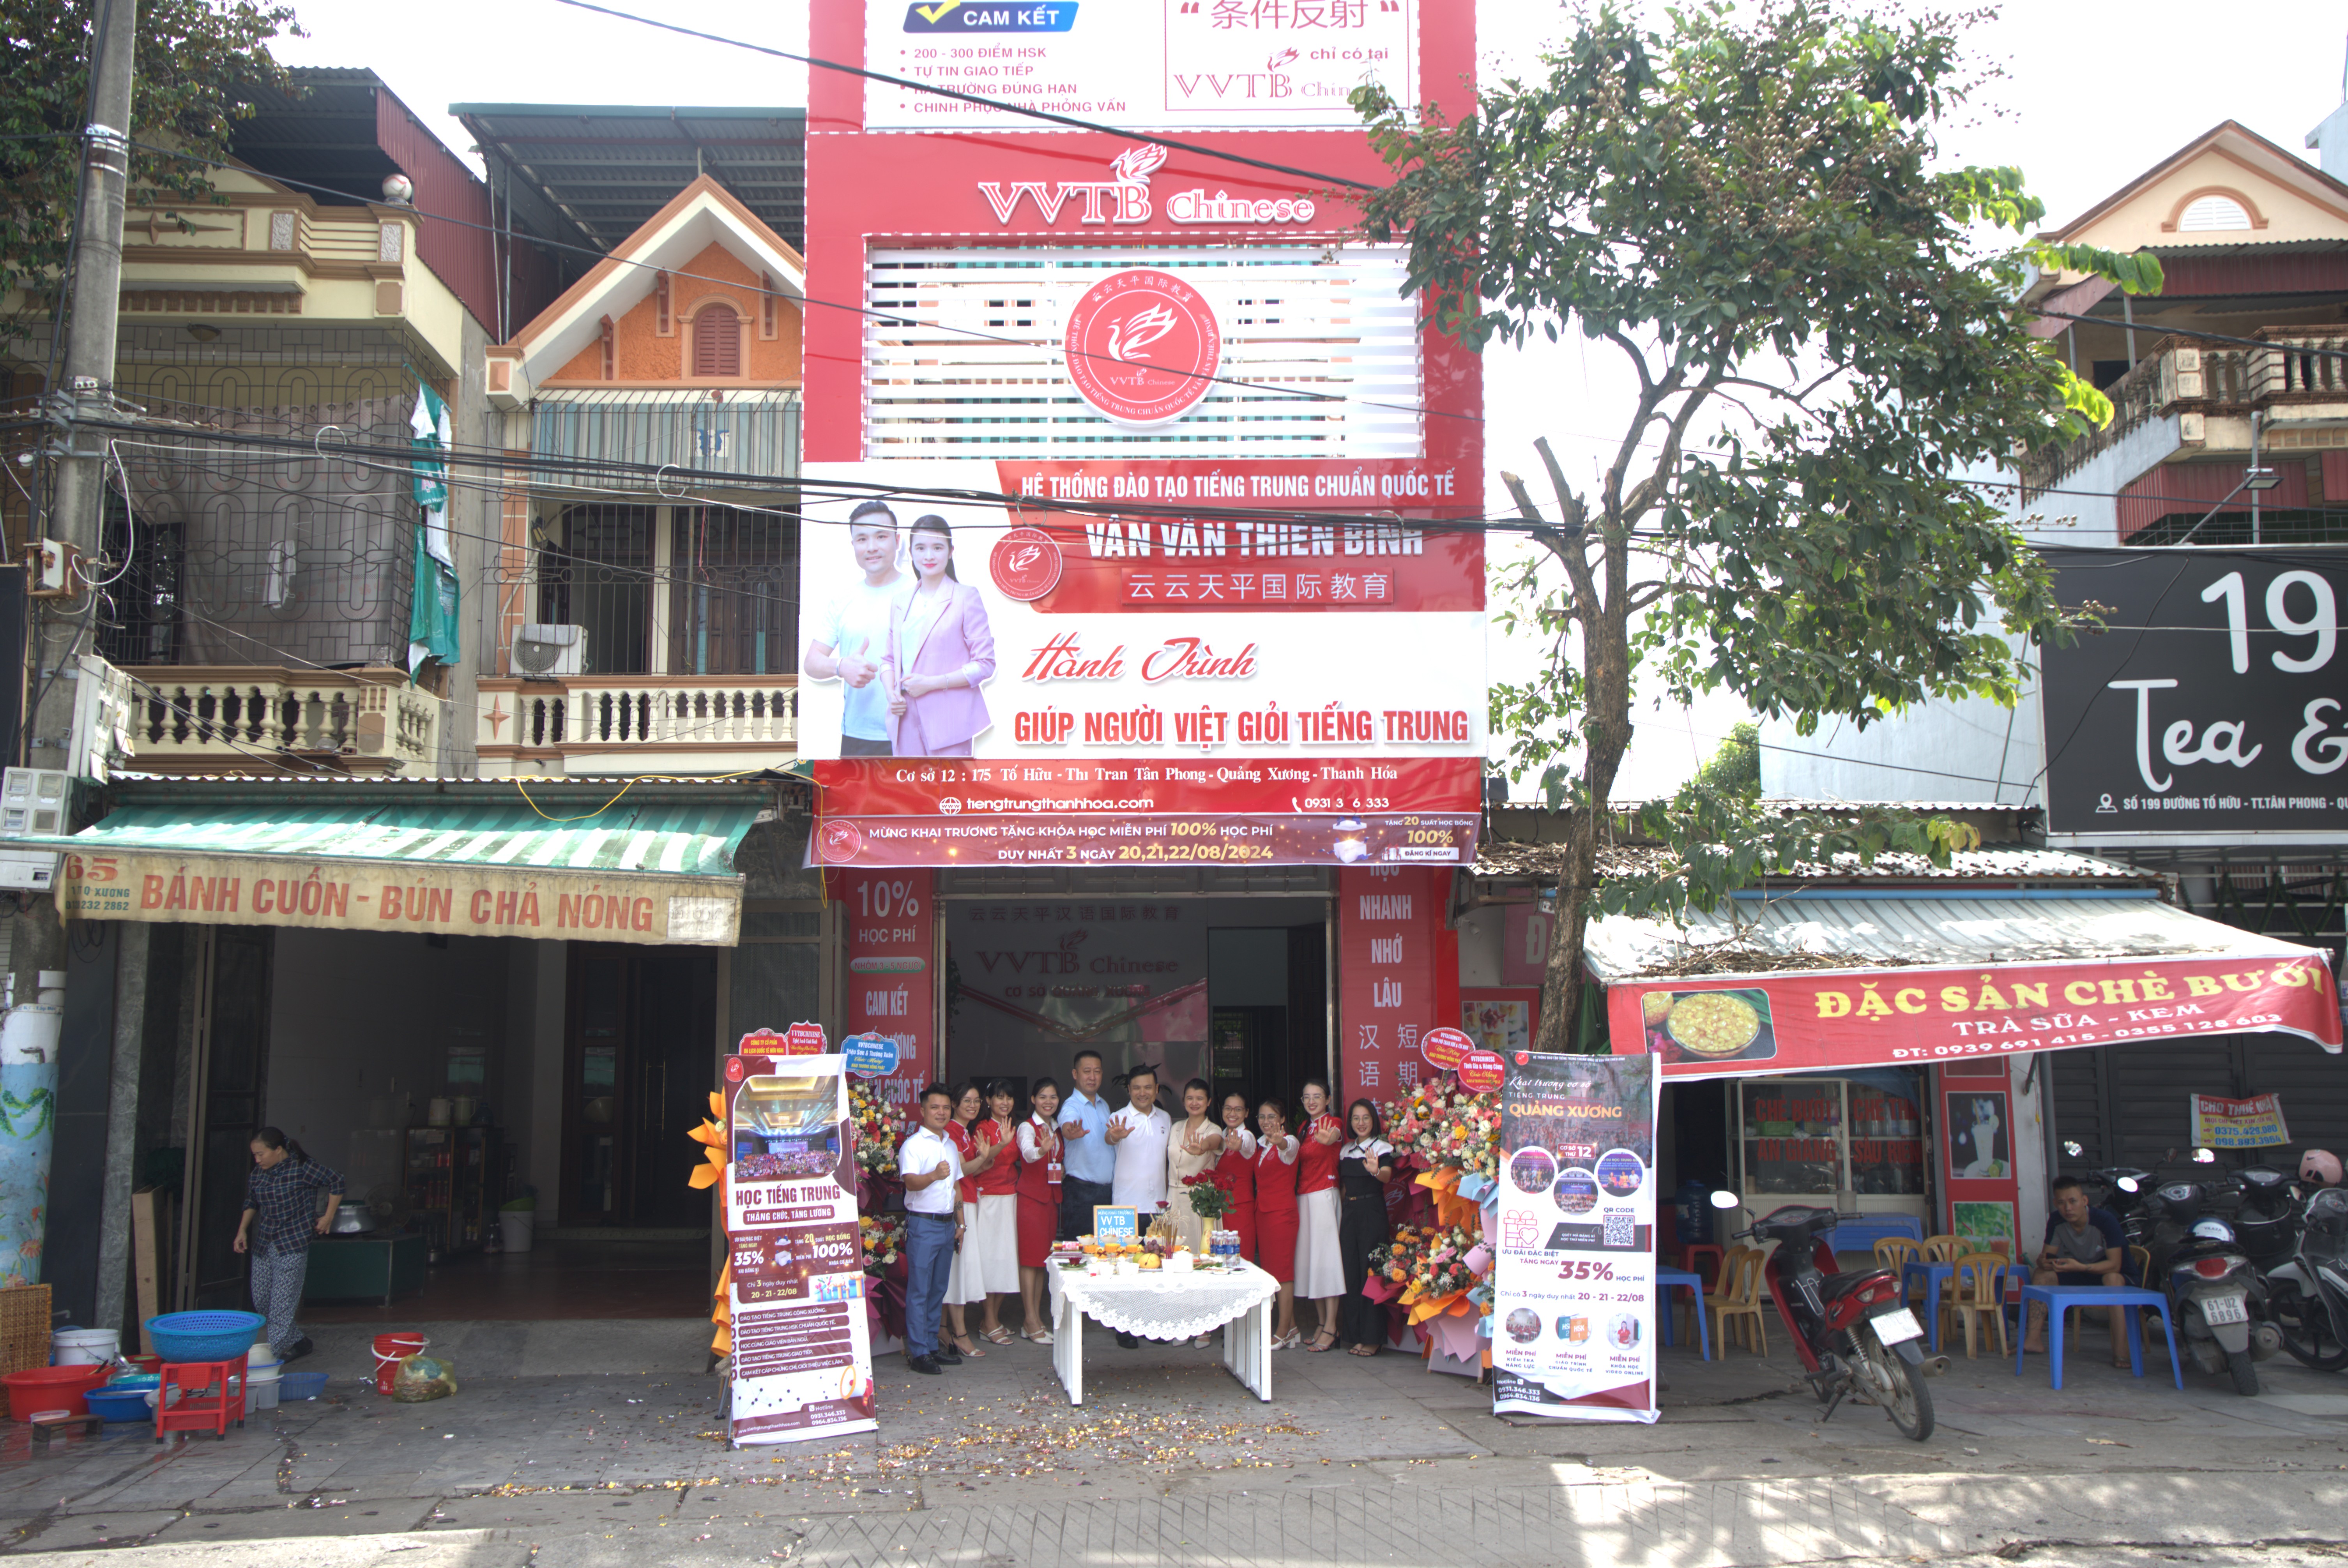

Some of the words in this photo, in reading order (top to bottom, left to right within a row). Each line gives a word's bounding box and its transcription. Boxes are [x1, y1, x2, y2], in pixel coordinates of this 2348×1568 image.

[963, 11, 1010, 26] CAM
[1017, 5, 1059, 25] KẾT
[914, 48, 937, 58] 200
[951, 48, 973, 58] 300
[978, 42, 1013, 58] ĐIỂM
[1017, 48, 1047, 58] HSK
[1310, 47, 1336, 60] chỉ
[1342, 48, 1362, 60] có
[1368, 48, 1388, 62] tại
[914, 65, 933, 78] TỰ
[937, 66, 959, 76] TIN
[964, 66, 999, 76] GIAO
[1003, 62, 1034, 76] TIẾP
[978, 182, 1152, 226] VVTB
[1166, 189, 1315, 225] Chinese
[1092, 275, 1194, 302] 云云天平国际教育
[1050, 469, 1108, 498] THỐNG
[1113, 471, 1149, 498] ĐÀO
[1155, 475, 1188, 502] TẠO
[1193, 469, 1245, 497] TIẾNG
[1250, 475, 1309, 497] TRUNG
[1315, 466, 1375, 497] CHUẨN
[1381, 466, 1429, 498] QUỐC
[1434, 466, 1455, 496] TẾ
[1129, 573, 1388, 600] 云云天平国际教育
[1022, 631, 1125, 681] Hành
[1141, 637, 1257, 682] Trình
[1014, 705, 1075, 743] GIÚP
[1084, 703, 1164, 743] NGƯỜI
[1174, 705, 1229, 749] VIỆT
[1237, 701, 1289, 743] GIỎI
[1296, 701, 1372, 742] TIẾNG
[1383, 710, 1468, 742] TRUNG
[2108, 678, 2263, 793] Tea
[2291, 697, 2348, 774] &
[896, 769, 915, 782] Cơ
[920, 767, 936, 782] sở
[941, 769, 956, 782] 12
[972, 768, 991, 782] 175
[1000, 764, 1018, 781] Tố
[1024, 767, 1052, 781] Hữu
[1134, 768, 1159, 781] Tân
[1165, 768, 1206, 783] Phong
[1216, 766, 1262, 783] Quảng
[1267, 766, 1310, 783] Xương
[1320, 766, 1364, 780] Thanh
[1370, 765, 1398, 780] Hóa
[1305, 798, 1331, 808] 0931
[1366, 798, 1390, 808] 333
[869, 825, 907, 839] MỪNG
[912, 827, 941, 837] KHAI
[944, 826, 997, 837] TRƯƠNG
[1001, 826, 1035, 839] TẶNG
[1038, 825, 1075, 837] KHÓA
[1079, 826, 1108, 839] HỌC
[1110, 823, 1144, 836] MIỄN
[1147, 824, 1167, 836] PHÍ
[1170, 822, 1216, 837] 100%
[1220, 825, 1247, 838] HỌC
[1252, 824, 1273, 836] PHÍ
[1407, 830, 1453, 844] 100%
[998, 849, 1026, 860] DUY
[1028, 846, 1063, 860] NHẤT
[1066, 846, 1077, 860] 3
[1080, 846, 1116, 860] NGÀY
[1118, 844, 1273, 862] 20,21,22/08/2024
[66, 855, 118, 882] 65
[140, 866, 240, 912] BÁNH
[252, 867, 350, 917] CUỐN
[378, 877, 453, 923] BÚN
[470, 881, 541, 927] CHẢ
[557, 884, 654, 932] NÓNG
[857, 880, 919, 918] 10%
[1360, 895, 1412, 920] NHANH
[971, 905, 1181, 922] 云云天平汉语国际教育
[859, 928, 889, 945] HỌC
[893, 925, 917, 942] PHÍ
[1371, 933, 1403, 963] NHỚ
[854, 959, 878, 971] NHÓM
[879, 962, 884, 970] 3
[890, 962, 895, 970] 5
[896, 959, 921, 971] NGƯỜI
[866, 990, 888, 1016] CAM
[890, 982, 909, 1016] KẾT
[1374, 977, 1402, 1008] LÂU
[1815, 981, 1927, 1022] ĐẶC
[1940, 974, 2049, 1012] SẢN
[2064, 970, 2175, 1006] CHÈ
[2183, 962, 2323, 996] BƯỞI
[1952, 1016, 2023, 1036] TRÀ
[2030, 1013, 2099, 1031] SỮA
[2126, 1003, 2205, 1022] KEM
[858, 1042, 884, 1050] VVTBCHINESE
[1892, 1047, 1928, 1058] ĐT:
[1934, 1043, 1993, 1055] 0939
[2000, 1038, 2041, 1050] 691
[2051, 1033, 2096, 1045] 415
[2115, 1024, 2176, 1038] 0355
[2184, 1019, 2230, 1031] 128
[2236, 1014, 2283, 1026] 603
[1509, 1100, 1564, 1117] QUẢNG
[1567, 1104, 1622, 1118] XƯƠNG
[1755, 1094, 1788, 1122] CHÈ
[1792, 1089, 1832, 1123] BƯỞI
[2200, 1099, 2224, 1114] CHO
[2227, 1100, 2256, 1116] THUÊ
[2255, 1095, 2273, 1113] NHÀ
[1757, 1138, 1780, 1161] AN
[1785, 1139, 1836, 1162] GIANG
[736, 1189, 762, 1208] HỌC
[766, 1184, 797, 1204] TIẾNG
[800, 1184, 841, 1201] TRUNG
[734, 1250, 764, 1266] 35%
[812, 1241, 853, 1259] 100%
[1520, 1257, 1538, 1266] TẶNG
[1558, 1261, 1614, 1281] 35%
[1616, 1293, 1644, 1302] 22/08
[2207, 1297, 2238, 1312] 61-U2
[2210, 1308, 2242, 1323] 6896
[1574, 1324, 1585, 1332] HSK
[1498, 1386, 1541, 1396] 0931.346.333
[810, 1409, 846, 1420] 0931.346.333
[812, 1415, 847, 1426] 0964.834.136
